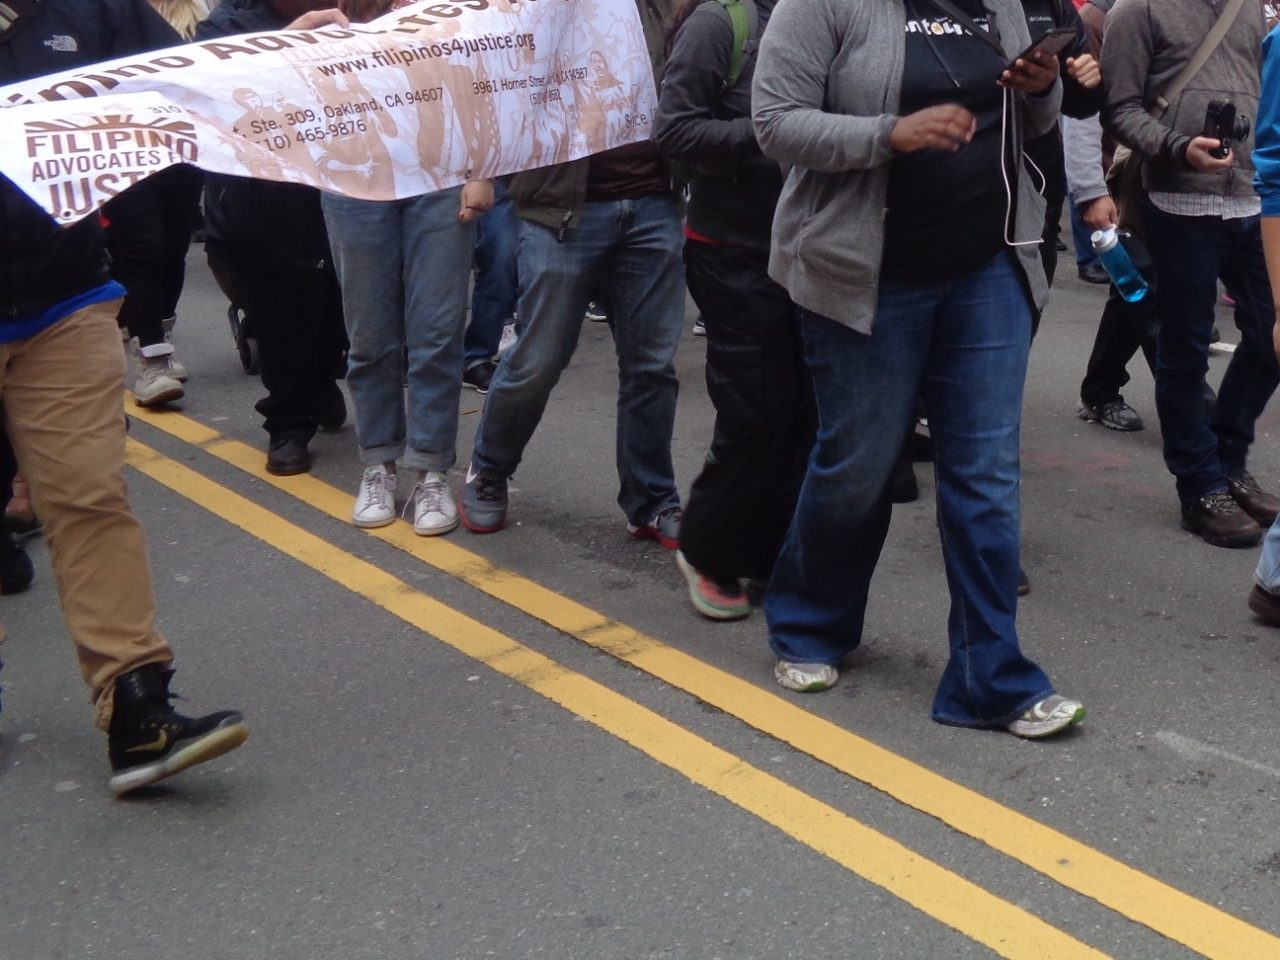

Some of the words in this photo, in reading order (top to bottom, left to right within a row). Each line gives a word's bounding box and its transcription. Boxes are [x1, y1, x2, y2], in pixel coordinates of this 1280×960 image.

[318, 33, 536, 77] www.filipinos4justice.org
[472, 80, 498, 94] 3961
[251, 119, 282, 135] Ste.
[324, 99, 383, 119] Oakland,
[385, 94, 404, 108] CA
[405, 87, 444, 104] 94607
[26, 129, 198, 162] FILIPINO
[296, 119, 367, 143] 465-9876
[32, 150, 161, 182] ADVOCATES
